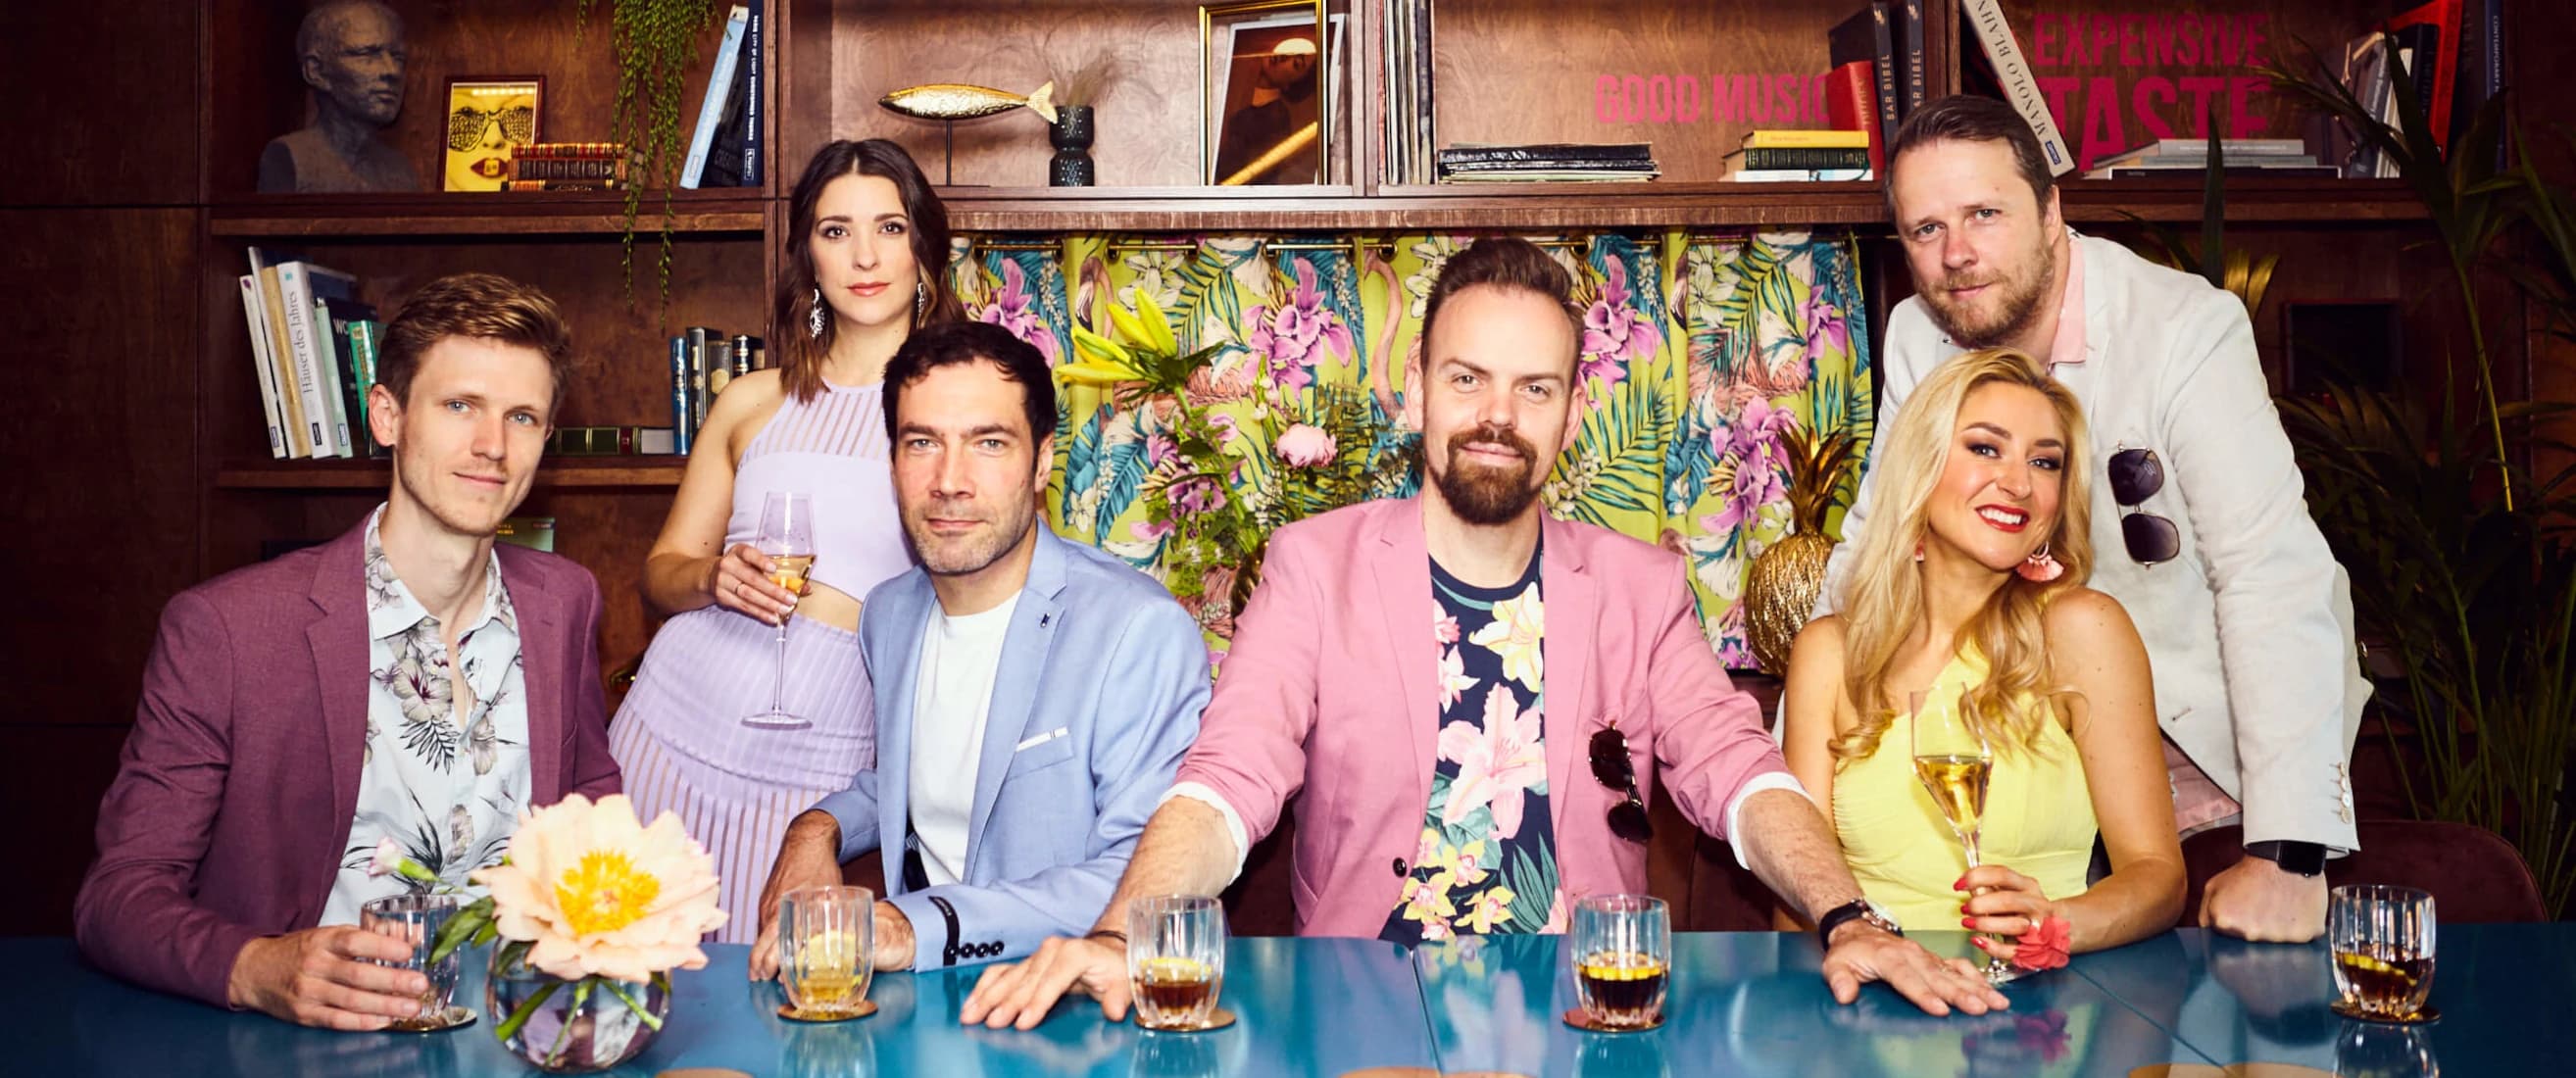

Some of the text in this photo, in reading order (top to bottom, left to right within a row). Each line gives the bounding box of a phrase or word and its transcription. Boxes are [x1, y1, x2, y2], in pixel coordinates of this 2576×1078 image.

[2034, 13, 2269, 67] EXPENSIVE
[1595, 74, 1830, 123] GOOD MUSIC
[1881, 54, 1896, 122] BAR BIBEL
[1911, 49, 1923, 108] AR BIBEL
[2006, 62, 2048, 143] MANOLO
[2036, 76, 2271, 172] TASTE
[288, 291, 314, 393] Häuser des Jahres
